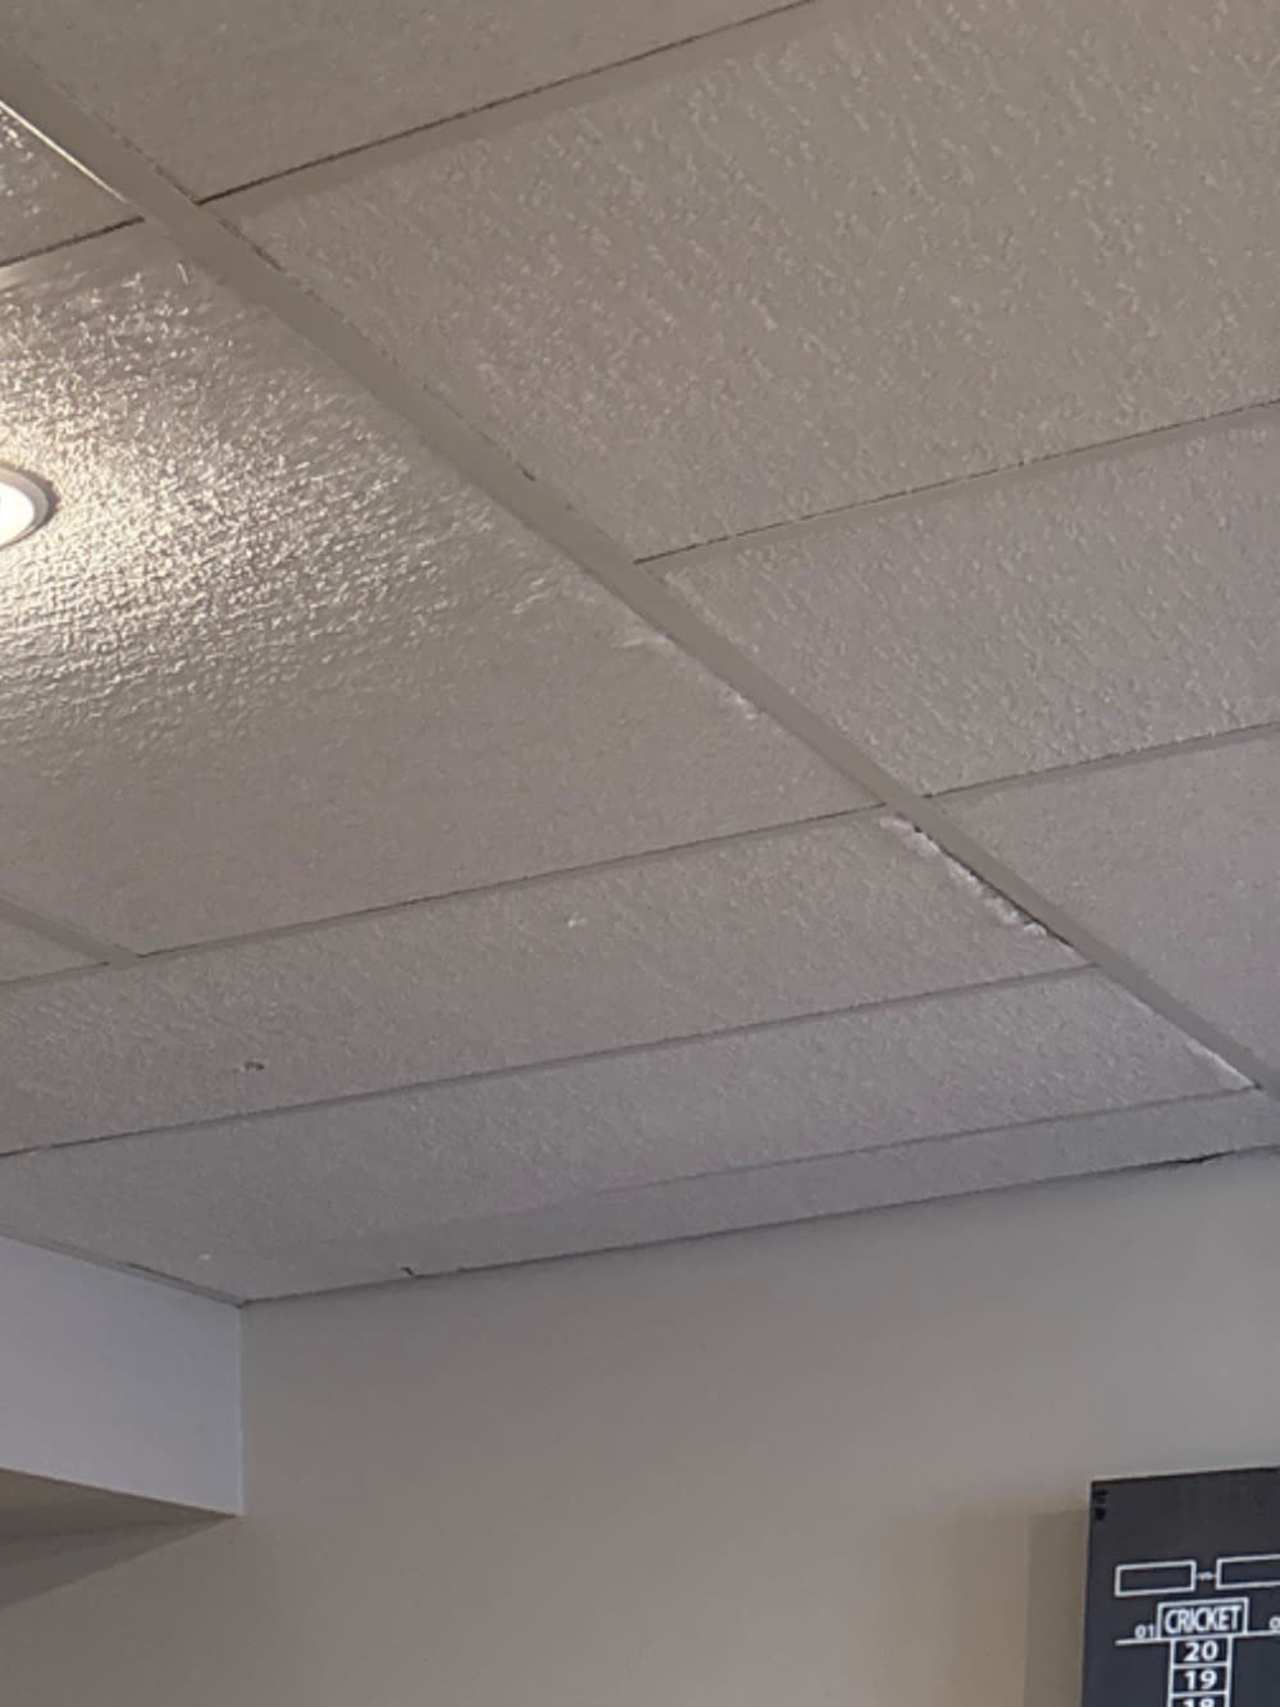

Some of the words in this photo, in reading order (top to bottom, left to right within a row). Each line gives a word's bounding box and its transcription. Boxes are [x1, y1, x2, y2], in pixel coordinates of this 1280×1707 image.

[1164, 1606, 1242, 1633] CRICKET
[1134, 1624, 1156, 1639] 01
[1184, 1641, 1218, 1662] 20
[1185, 1670, 1217, 1690] 19
